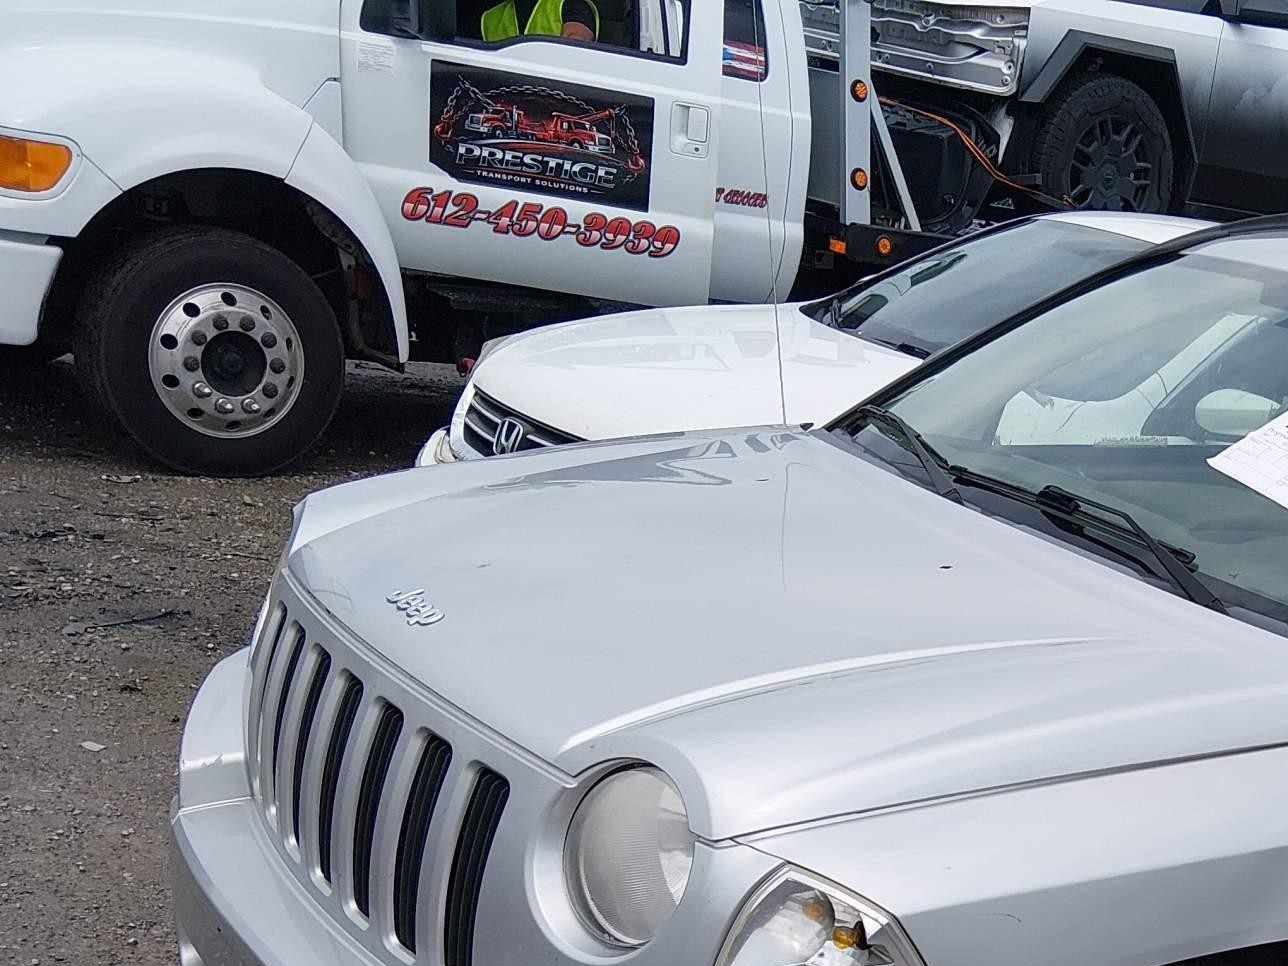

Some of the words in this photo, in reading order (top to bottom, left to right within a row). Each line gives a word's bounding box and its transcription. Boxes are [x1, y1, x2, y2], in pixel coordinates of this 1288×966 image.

[455, 142, 618, 189] PRESTIGE
[476, 169, 532, 184] TRANSPORT
[535, 179, 589, 194] SOLUTIONS
[400, 186, 681, 258] 612-450-3939
[385, 588, 446, 627] Jeep
